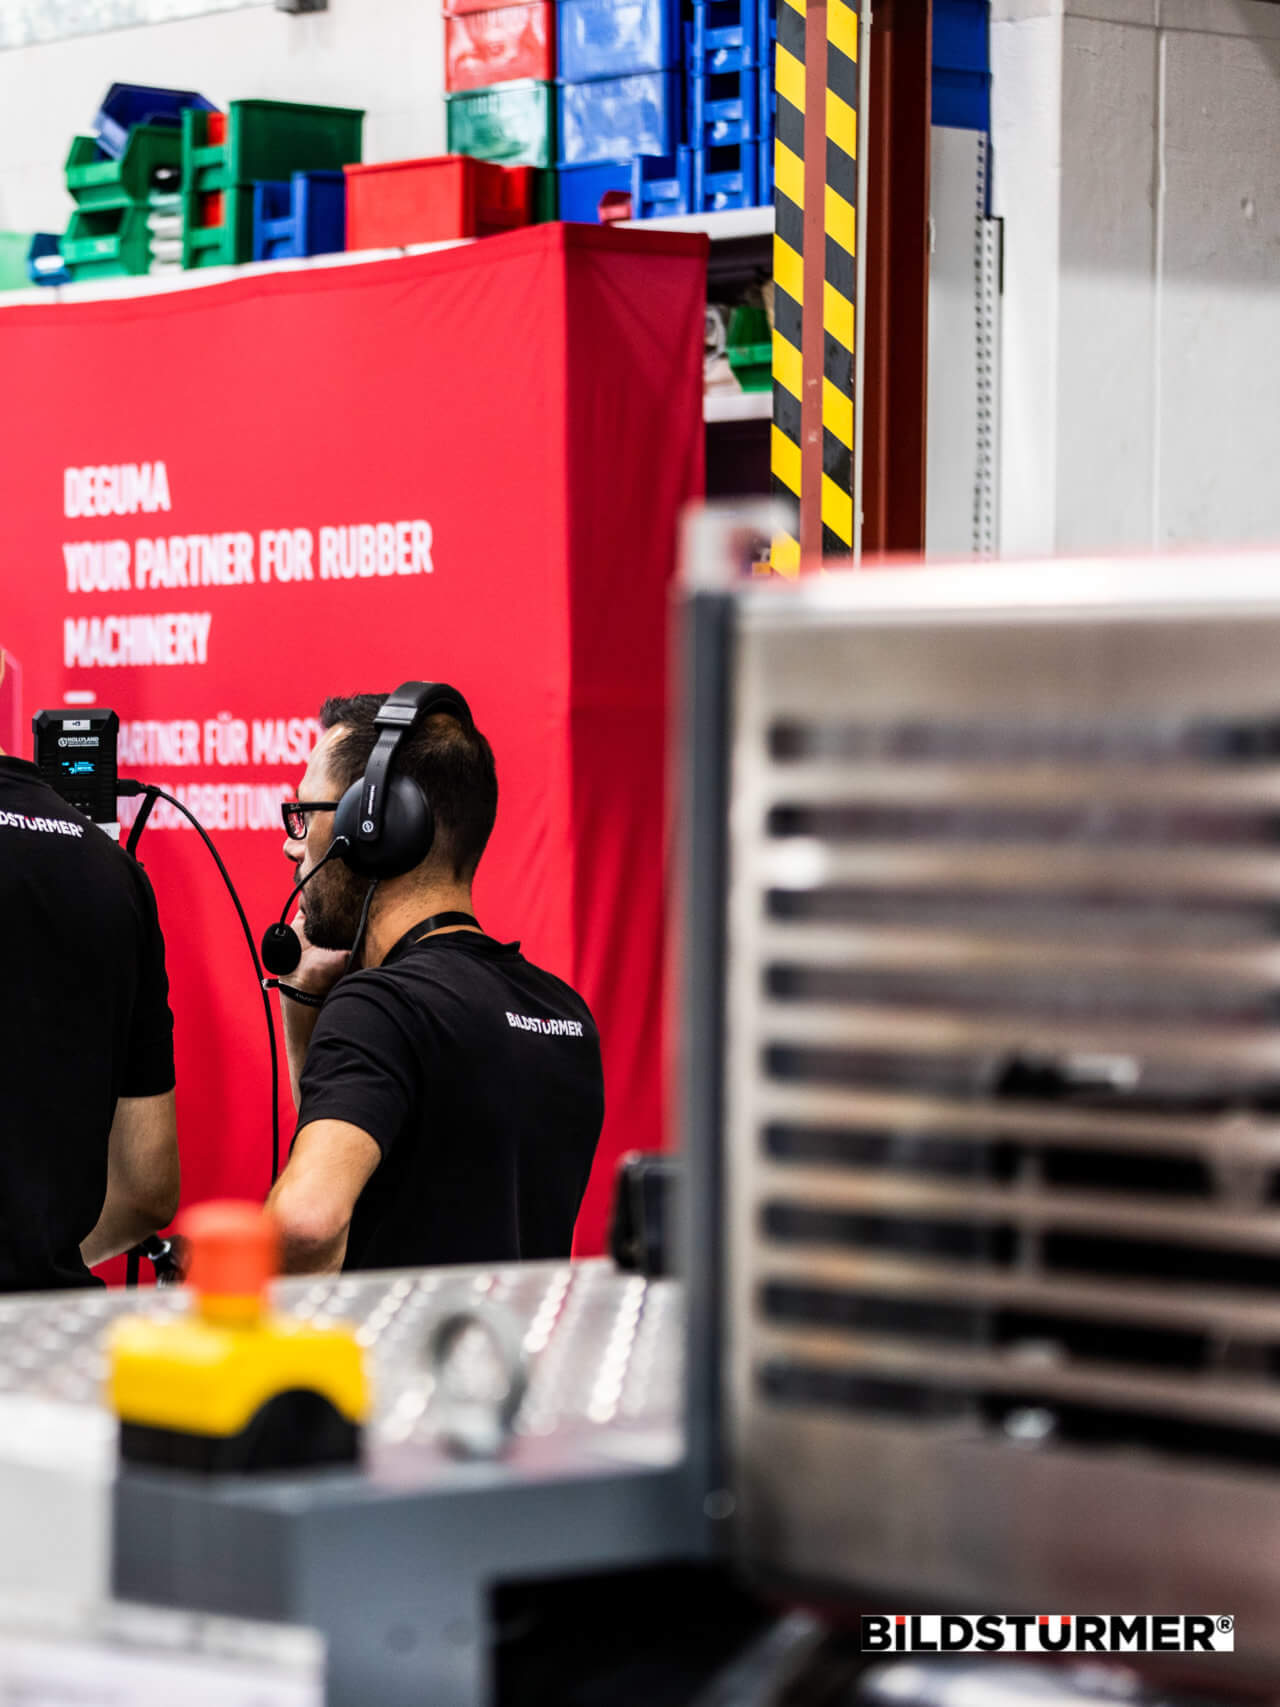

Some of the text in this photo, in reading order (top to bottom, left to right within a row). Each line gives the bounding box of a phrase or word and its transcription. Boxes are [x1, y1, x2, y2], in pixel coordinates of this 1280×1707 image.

[63, 461, 172, 519] DEGUMA
[62, 519, 433, 593] YOUR PARTNER FOR RUBBER
[63, 611, 212, 668] MACHINERY
[117, 711, 323, 767] ARTNER FÜR MASC
